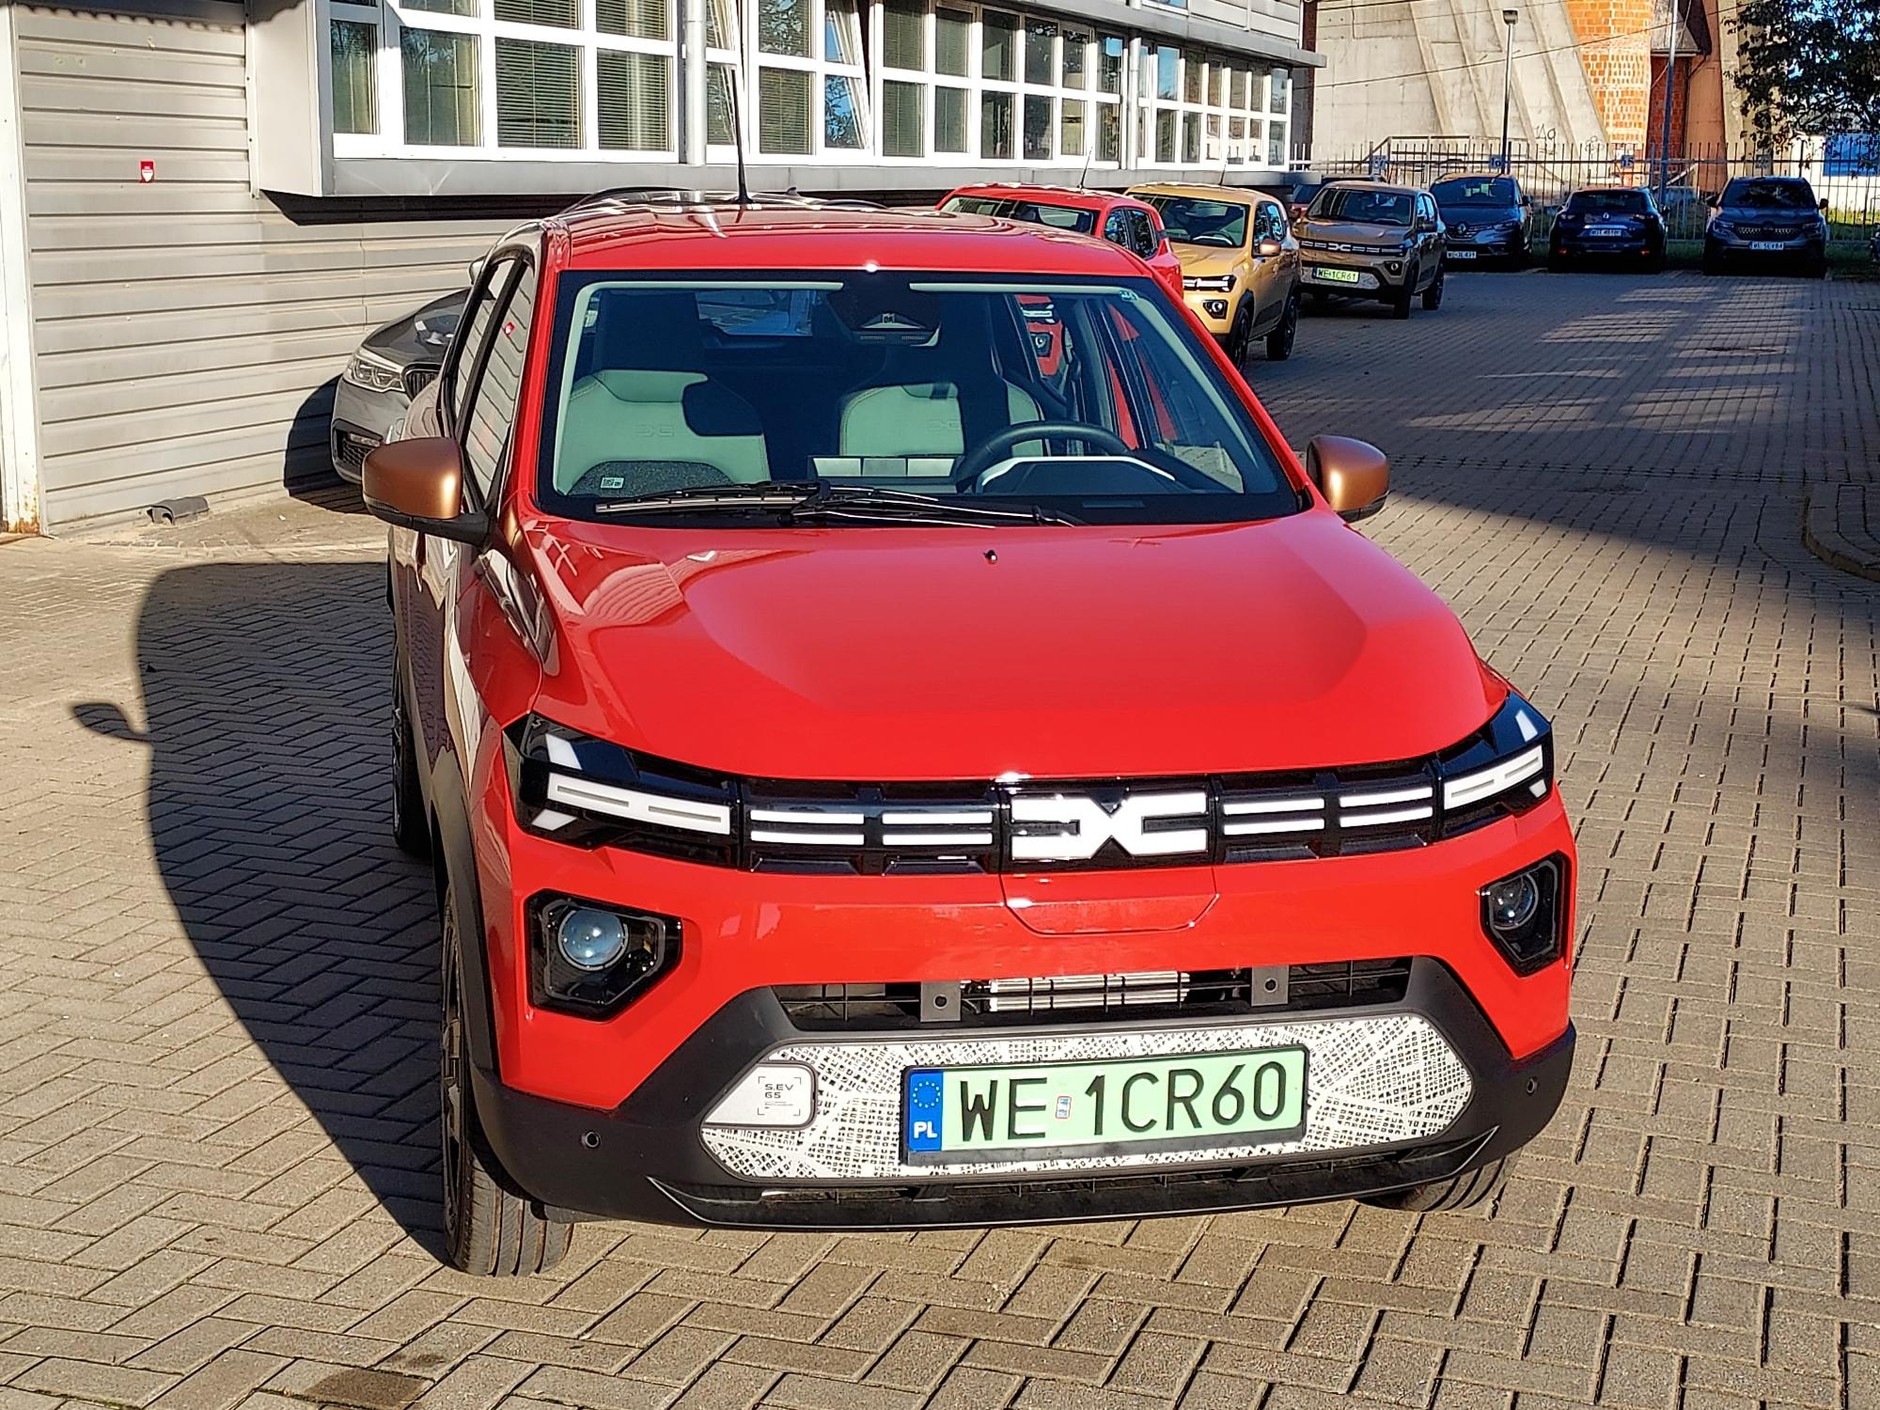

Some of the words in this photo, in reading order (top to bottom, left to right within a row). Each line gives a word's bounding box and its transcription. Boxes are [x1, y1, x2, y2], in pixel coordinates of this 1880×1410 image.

[959, 1076, 1048, 1142] WE
[1084, 1060, 1288, 1137] 1CR60
[912, 1120, 938, 1140] PL
